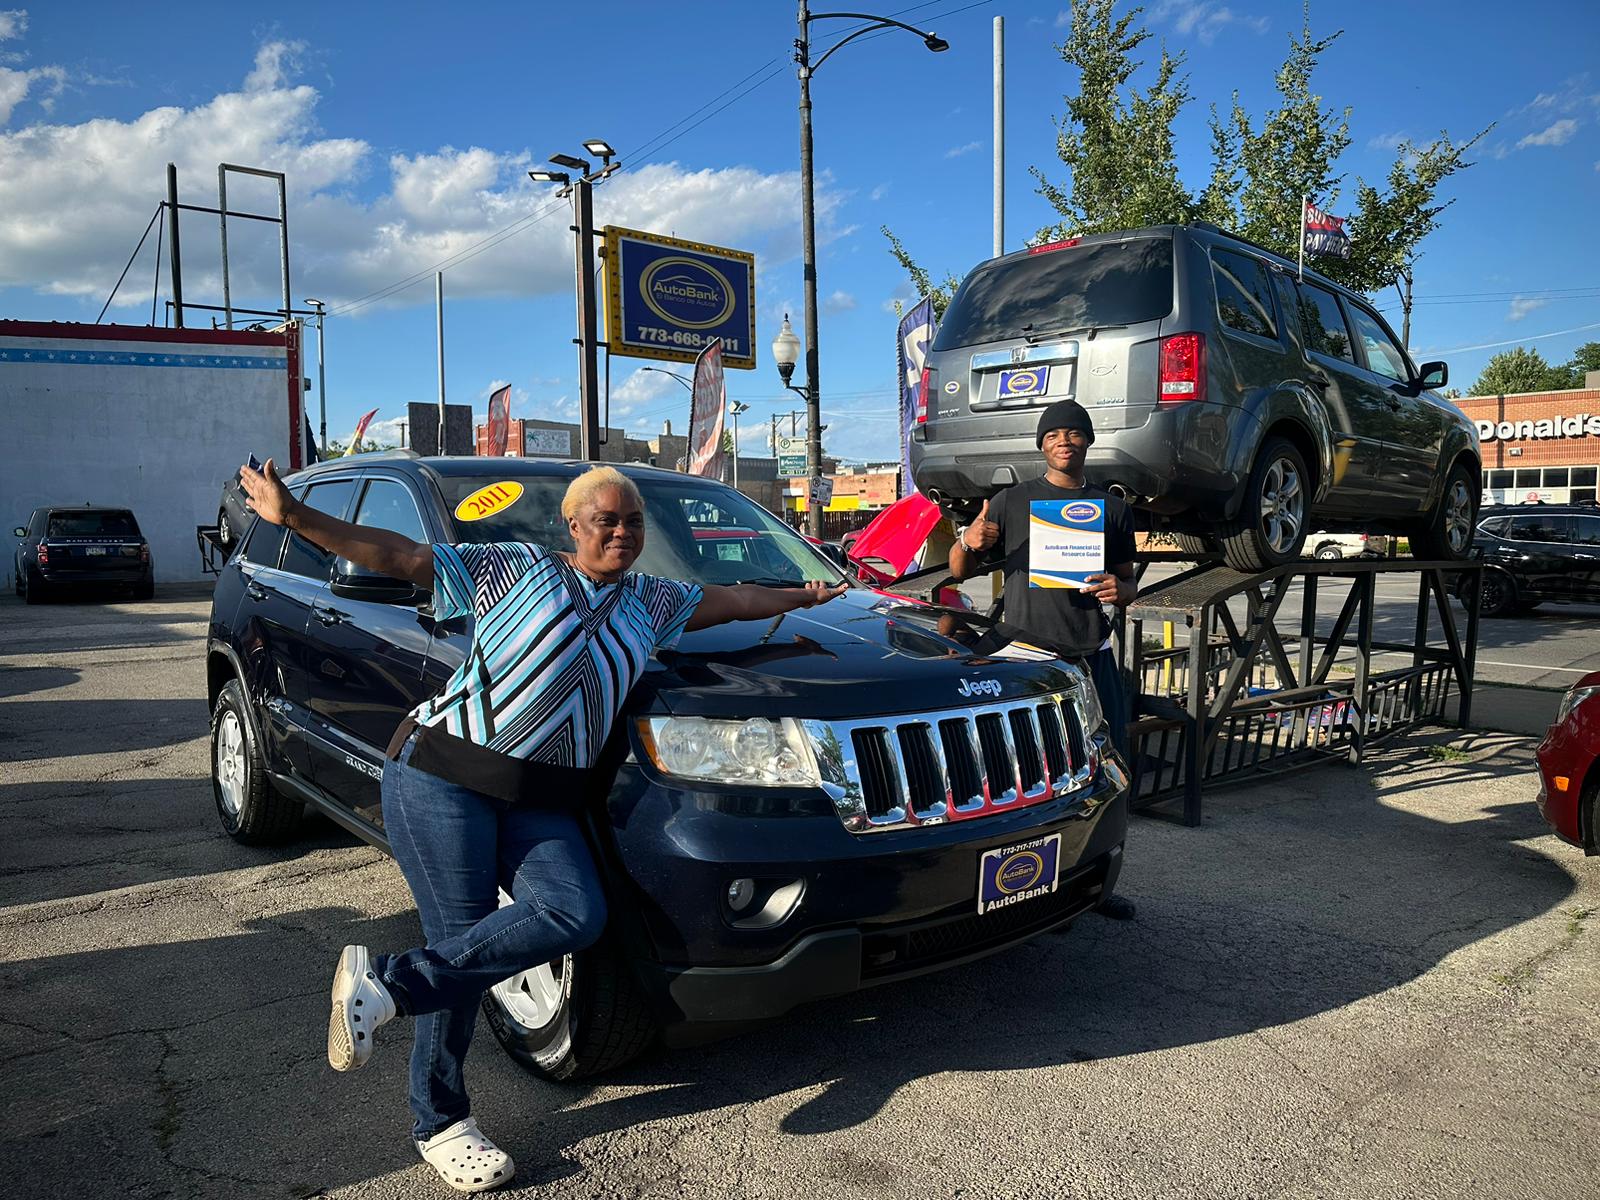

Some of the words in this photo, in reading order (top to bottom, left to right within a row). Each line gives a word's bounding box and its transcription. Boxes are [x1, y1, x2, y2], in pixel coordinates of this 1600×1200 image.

[653, 281, 719, 302] AutoBank
[468, 485, 512, 515] 2011
[957, 678, 1002, 697] Jeep
[1002, 839, 1044, 855] 773-717-7707
[1002, 865, 1034, 880] AutoBank
[986, 885, 1049, 912] AutoBank
